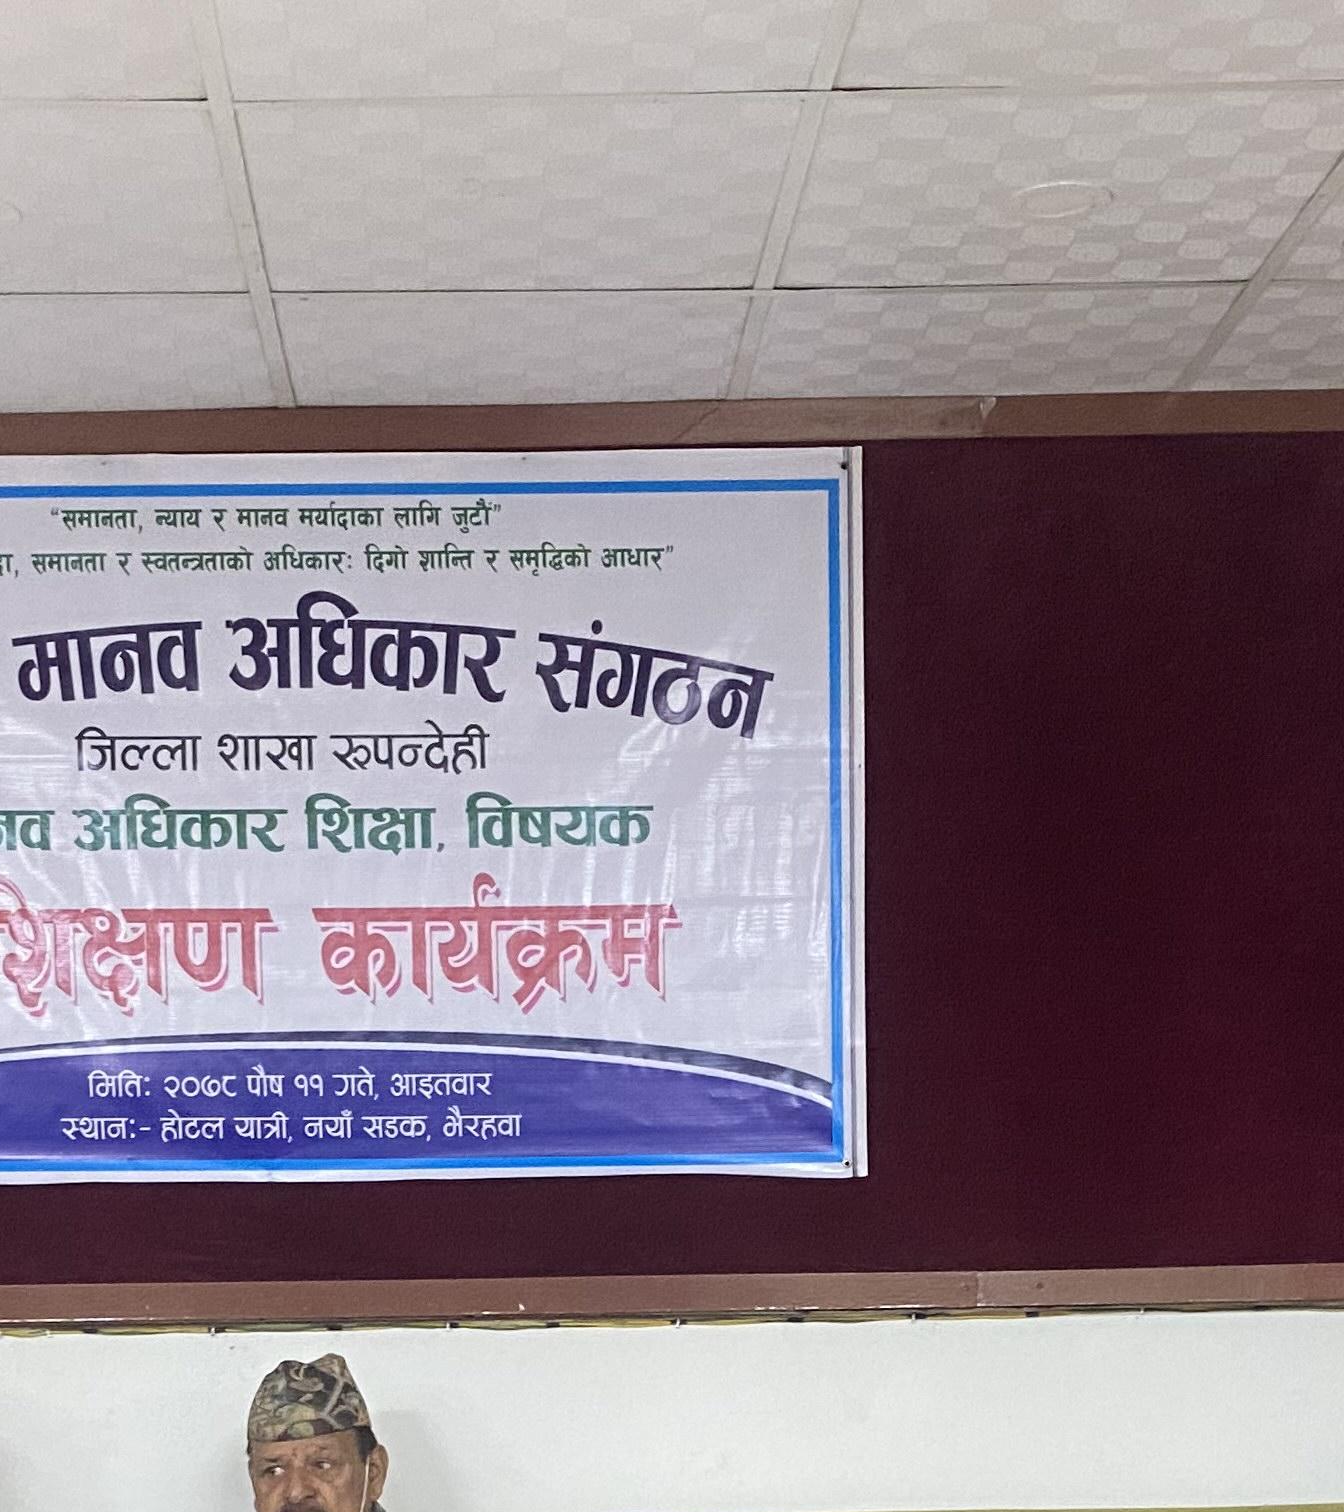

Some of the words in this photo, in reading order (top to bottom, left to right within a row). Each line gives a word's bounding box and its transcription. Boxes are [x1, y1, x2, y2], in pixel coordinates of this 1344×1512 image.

[153, 508, 203, 529] न्याय
[209, 508, 229, 533] र
[235, 507, 291, 529] मानव
[297, 500, 385, 531] मर्यादाका
[392, 498, 443, 530] लागि
[30, 552, 108, 576] समानता
[114, 552, 133, 577] र
[140, 545, 255, 575] स्वतन्त्रताको
[362, 542, 410, 574] दिगो
[416, 542, 476, 573] शान्ति
[482, 549, 501, 574] र
[507, 540, 593, 577] समृद्धिको
[10, 620, 204, 703] मानव
[225, 590, 517, 704] अधिकार
[534, 619, 776, 740] संगठन
[73, 725, 203, 772] जिल्ला
[216, 733, 319, 772] शाखा
[71, 792, 289, 853] अधिकार
[464, 790, 655, 849] विषयक
[312, 873, 682, 1014] कार्यक्रम
[163, 1074, 237, 1099] २०७८
[245, 1063, 286, 1097] पौष
[293, 1073, 324, 1097] ११
[389, 1072, 494, 1100] आइतवार
[159, 1108, 227, 1143] होटल
[302, 1108, 355, 1139] नयाँ
[442, 1104, 523, 1141] भैरहवा
